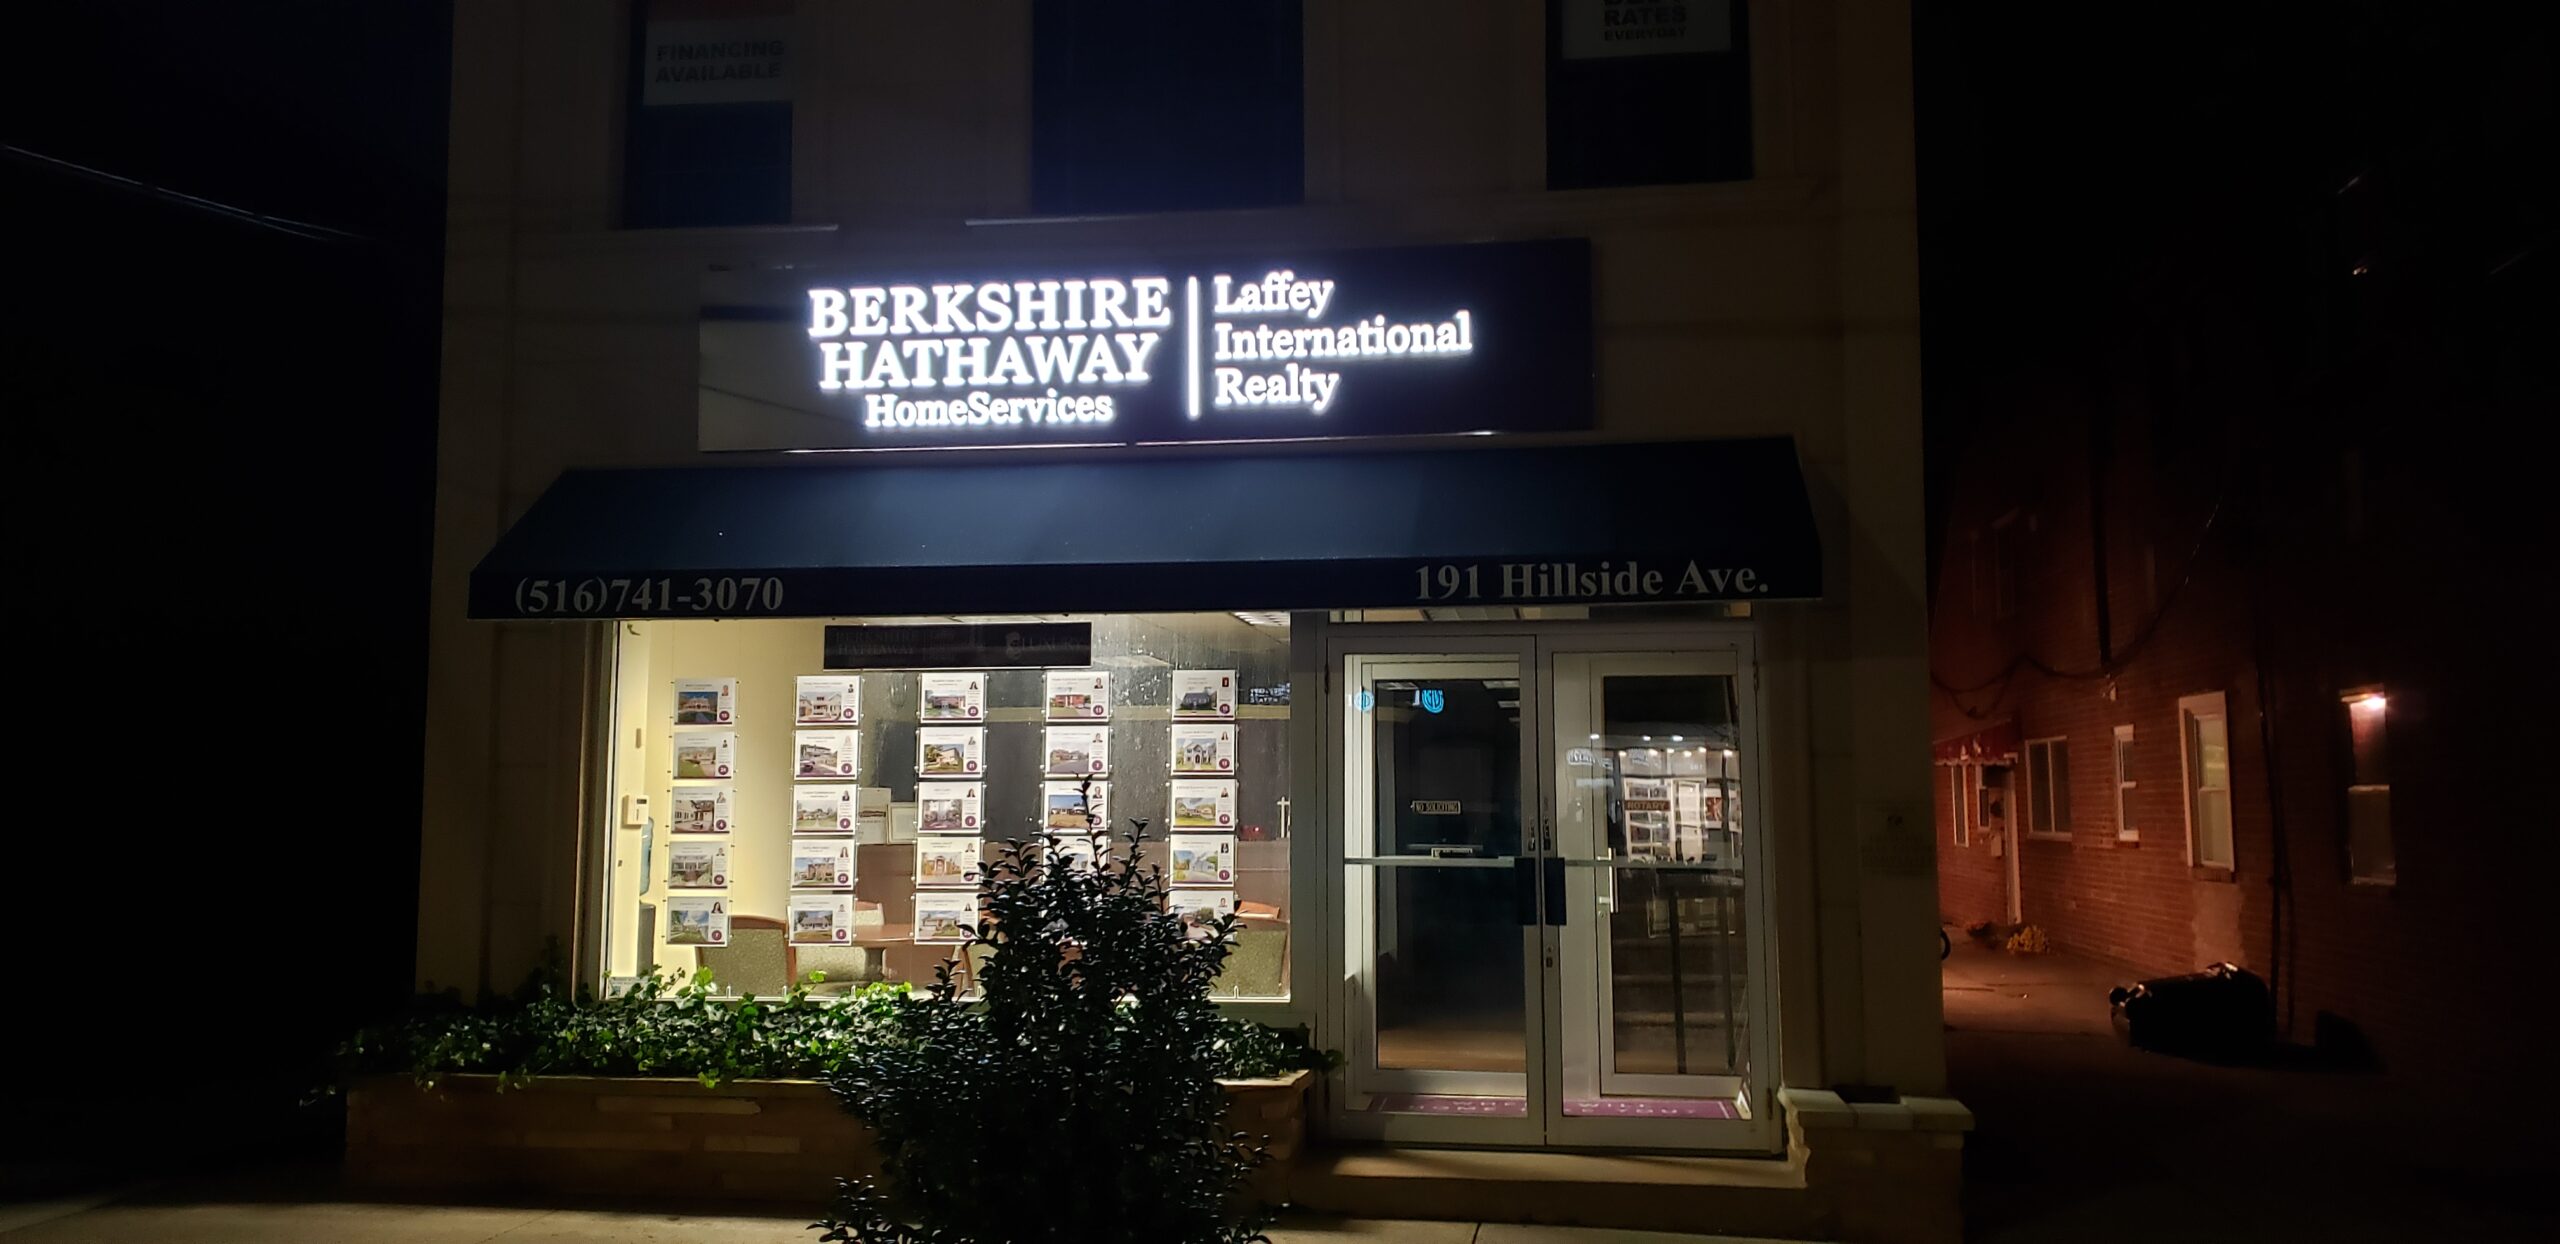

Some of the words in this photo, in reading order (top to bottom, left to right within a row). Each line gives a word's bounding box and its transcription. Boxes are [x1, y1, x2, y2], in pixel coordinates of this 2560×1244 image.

[1604, 7, 1686, 26] RATES
[655, 61, 782, 82] AVAILABLE
[656, 40, 785, 61] FINANCING
[807, 278, 1171, 337] BERKSHIRE
[1213, 269, 1334, 319] Laffey
[1214, 309, 1473, 360] International
[819, 332, 1159, 390] HATHAWAY
[864, 387, 1113, 428] HomeServices
[1214, 362, 1340, 412] Realty
[514, 576, 784, 614] (516)741-3070
[1415, 563, 1482, 600] 191
[1500, 560, 1664, 599] Hillside
[1674, 558, 1770, 594] Ave.
